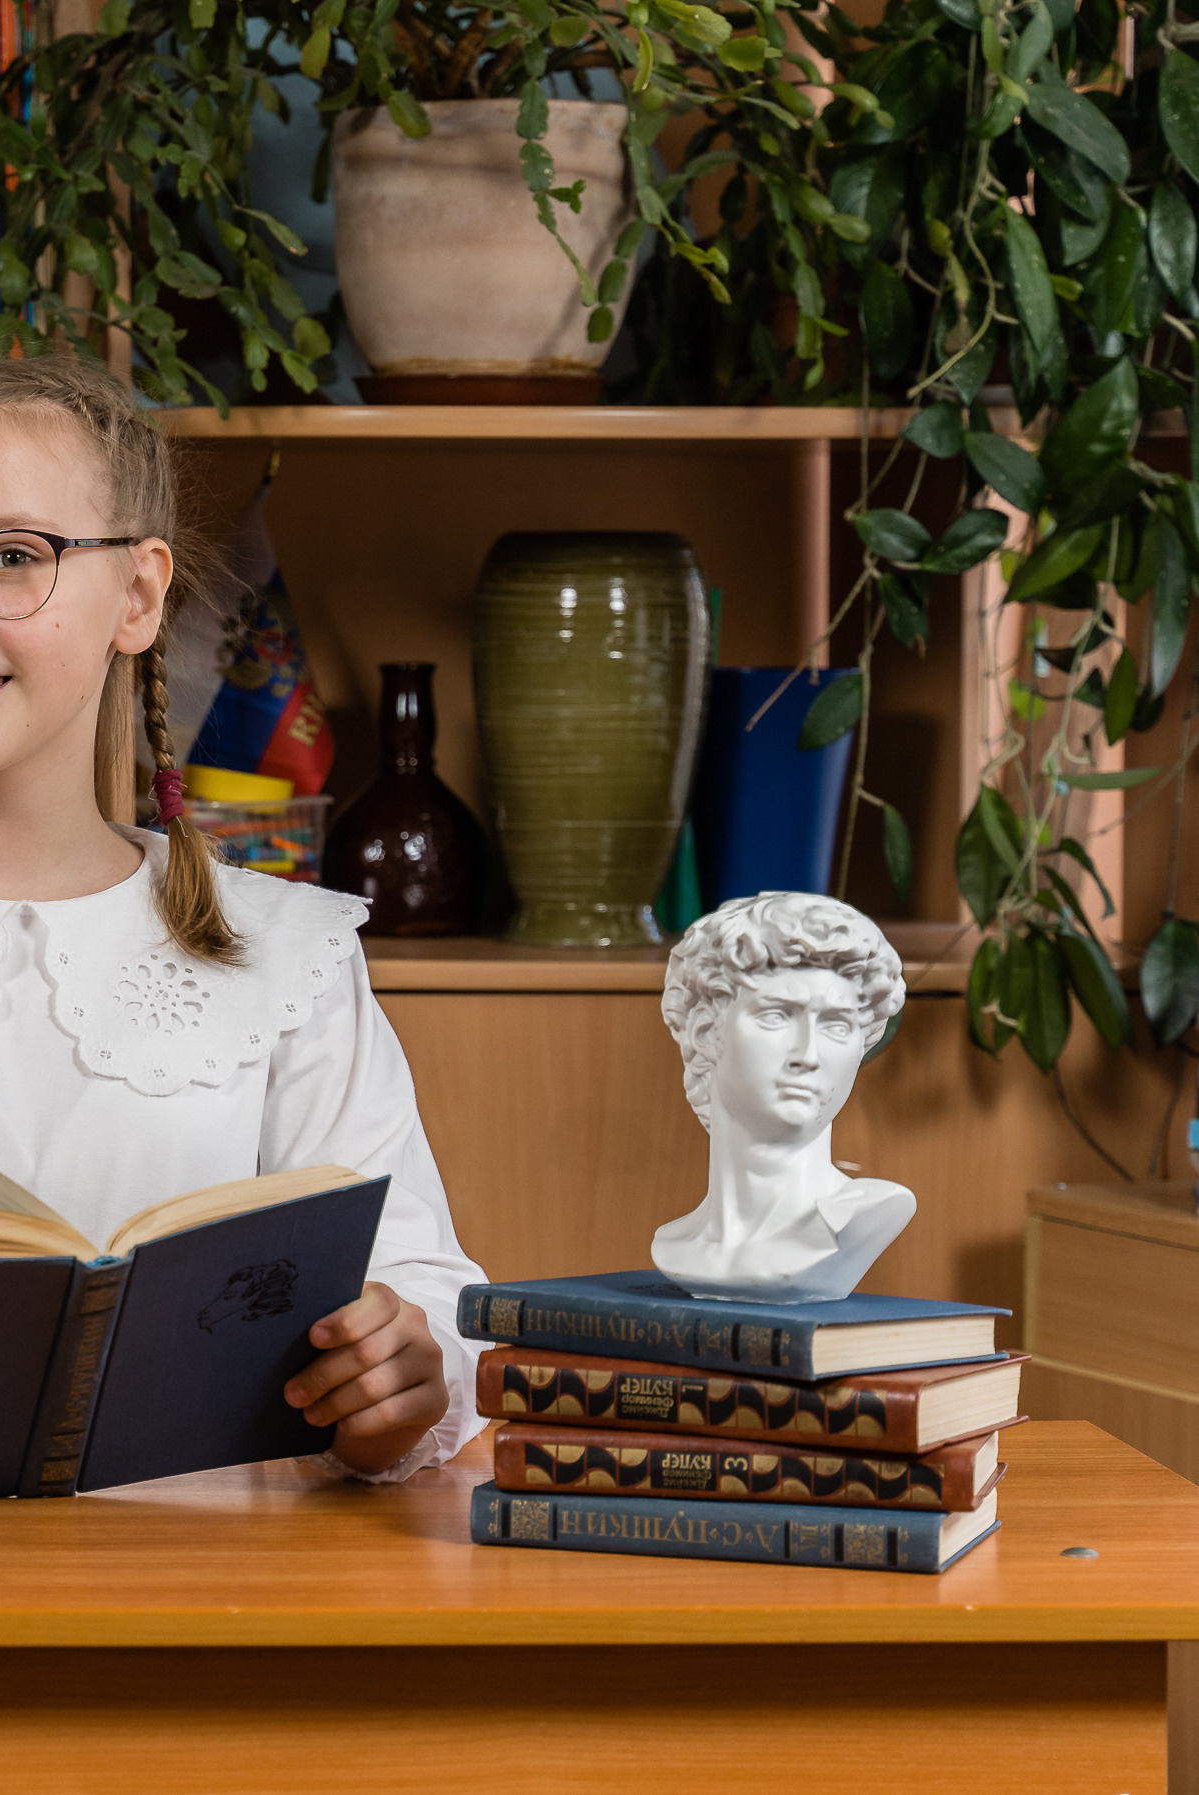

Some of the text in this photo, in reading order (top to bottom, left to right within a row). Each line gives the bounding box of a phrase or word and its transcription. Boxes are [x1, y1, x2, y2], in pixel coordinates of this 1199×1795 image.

[621, 1378, 673, 1396] КУПЕР
[621, 1394, 674, 1408] Фенимор
[622, 1405, 669, 1418] Джеймс
[661, 1454, 711, 1470] КУПЕР
[725, 1456, 747, 1471] 3
[662, 1468, 712, 1480] Фенимор
[663, 1478, 707, 1490] Джеймс
